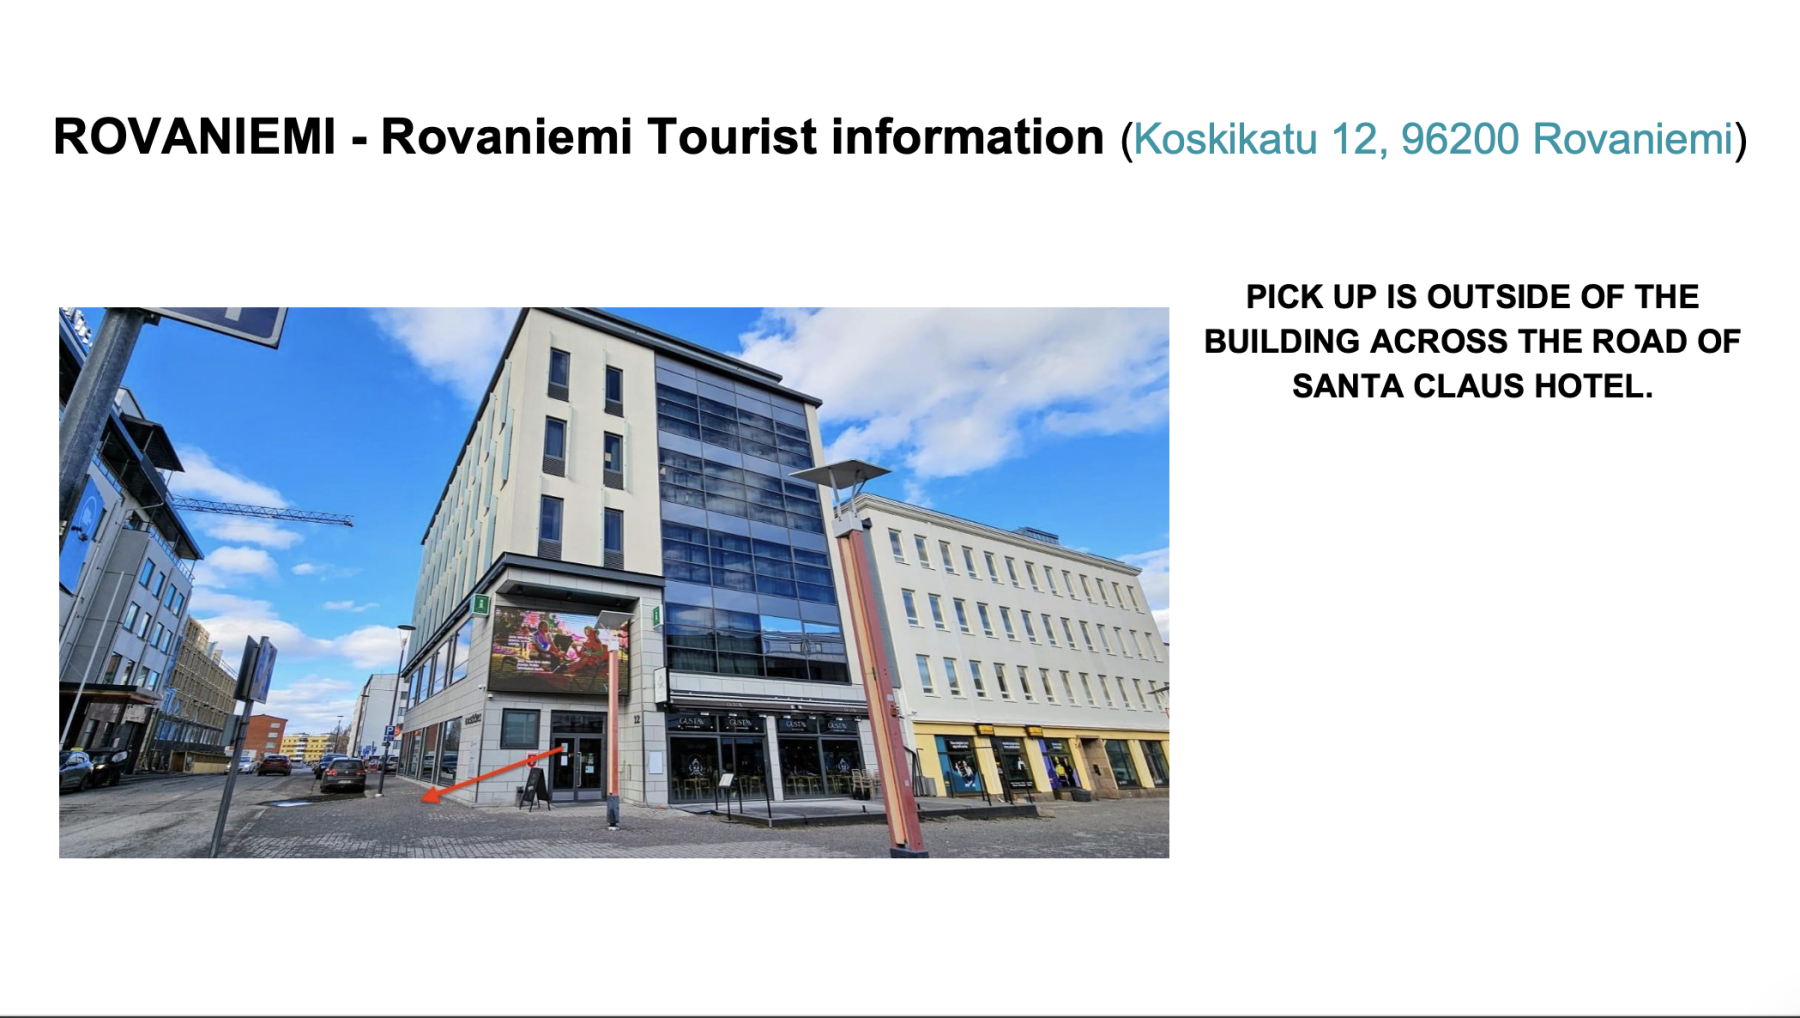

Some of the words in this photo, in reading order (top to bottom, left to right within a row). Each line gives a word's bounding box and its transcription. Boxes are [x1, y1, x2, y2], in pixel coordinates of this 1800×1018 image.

[634, 714, 641, 724] 12
[679, 717, 705, 725] GUSTAV
[729, 718, 752, 726] GUSTAV
